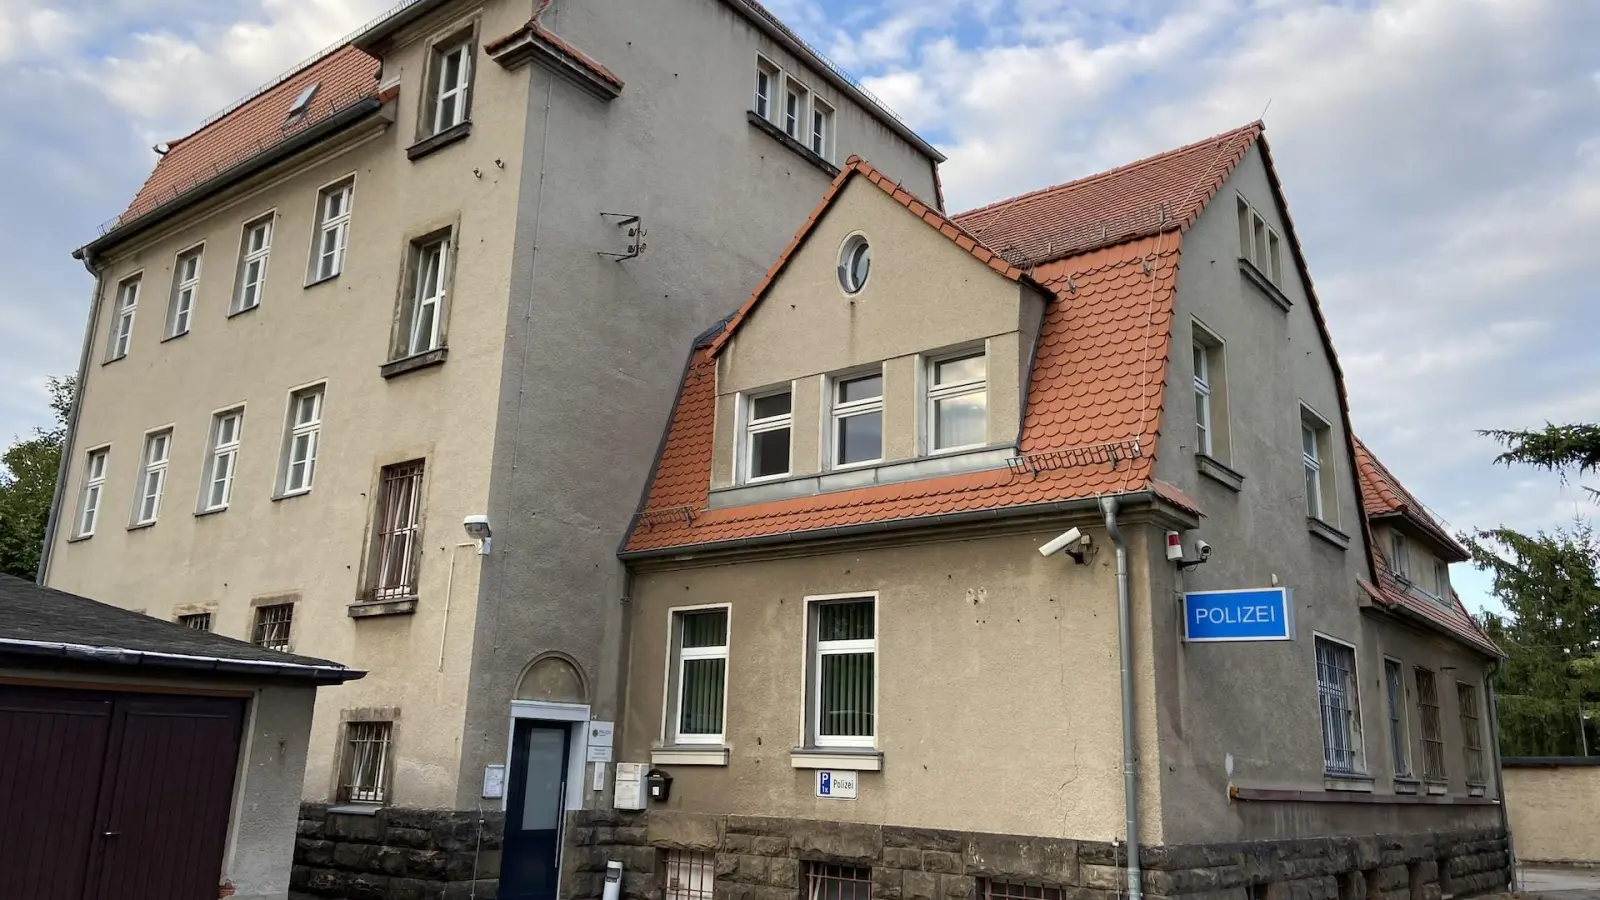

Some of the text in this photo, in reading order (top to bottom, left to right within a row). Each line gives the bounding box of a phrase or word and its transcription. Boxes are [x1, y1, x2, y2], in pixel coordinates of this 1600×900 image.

[1195, 605, 1275, 624] POLIZEI
[822, 773, 829, 784] P
[833, 779, 854, 789] Polizei
